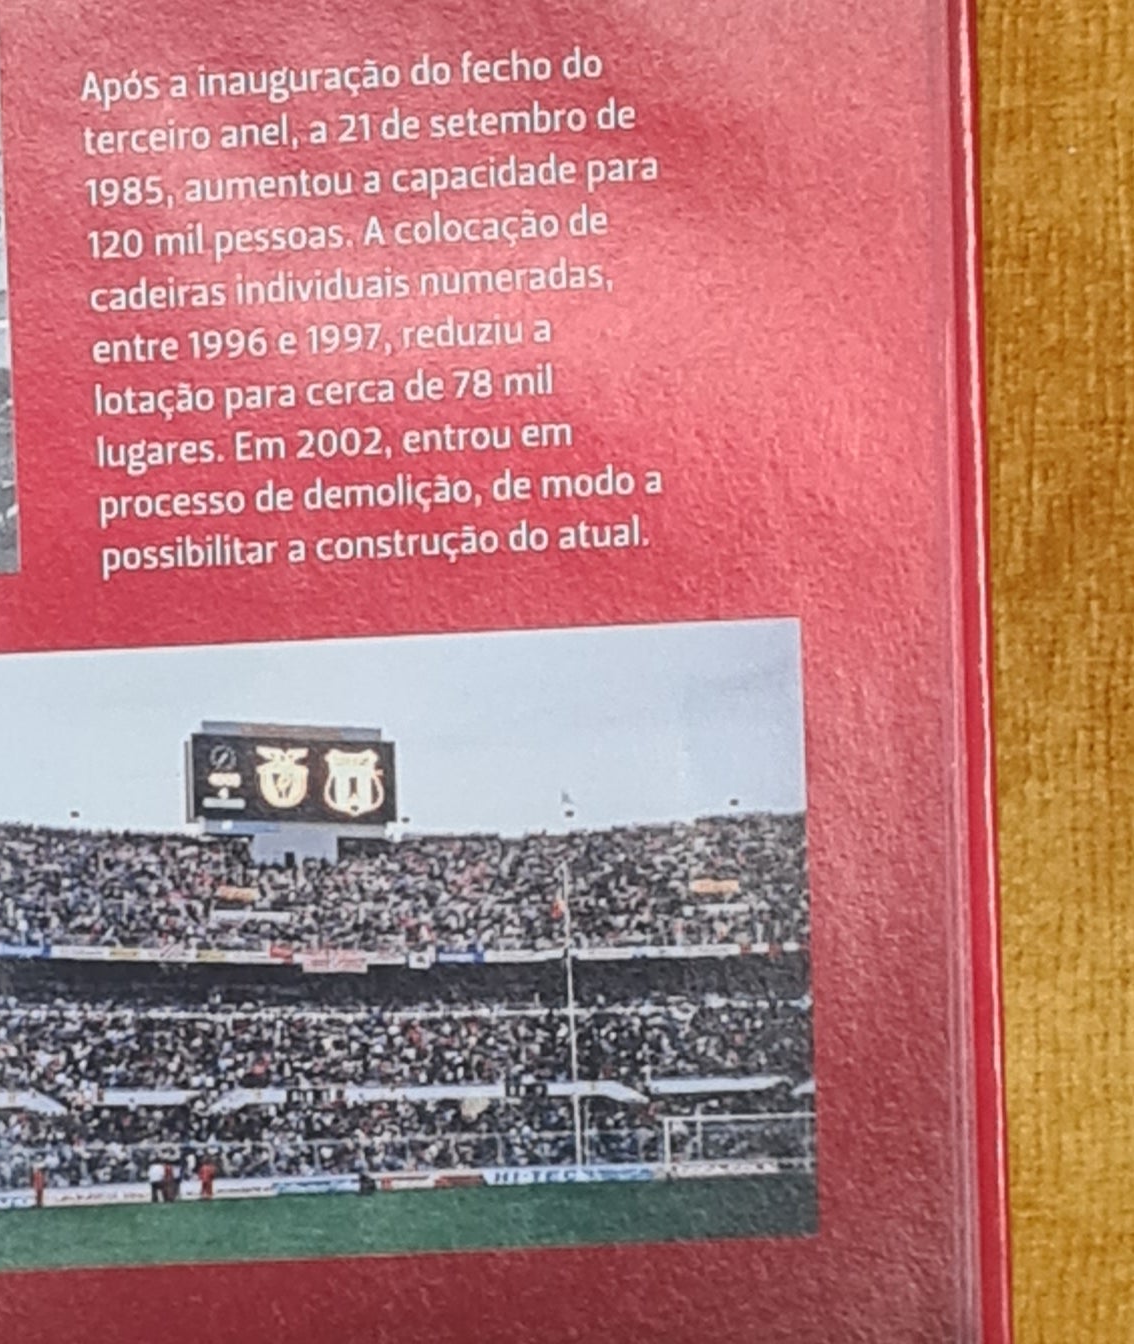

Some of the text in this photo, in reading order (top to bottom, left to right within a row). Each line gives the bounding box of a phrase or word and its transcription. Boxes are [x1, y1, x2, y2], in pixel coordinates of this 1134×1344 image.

[80, 47, 603, 110] Após a inauguração do fecho do
[84, 97, 636, 155] terceiro anel, a 21 de setembro de
[85, 152, 659, 208] 1985, aumentou a capacidade para
[88, 204, 608, 261] 120 mil pessoas. A colocação de
[90, 257, 614, 312] cadeiras individuais numeradas,
[92, 313, 551, 364] entre 1996 e 1997, reduziu a
[94, 364, 553, 420] lotação para cerca de 78 mil
[97, 420, 573, 475] lugares. Em 2002, entrou em
[100, 465, 663, 528] processo de demolição, de modo a
[102, 514, 649, 580] possibilitar a construção do atual.
